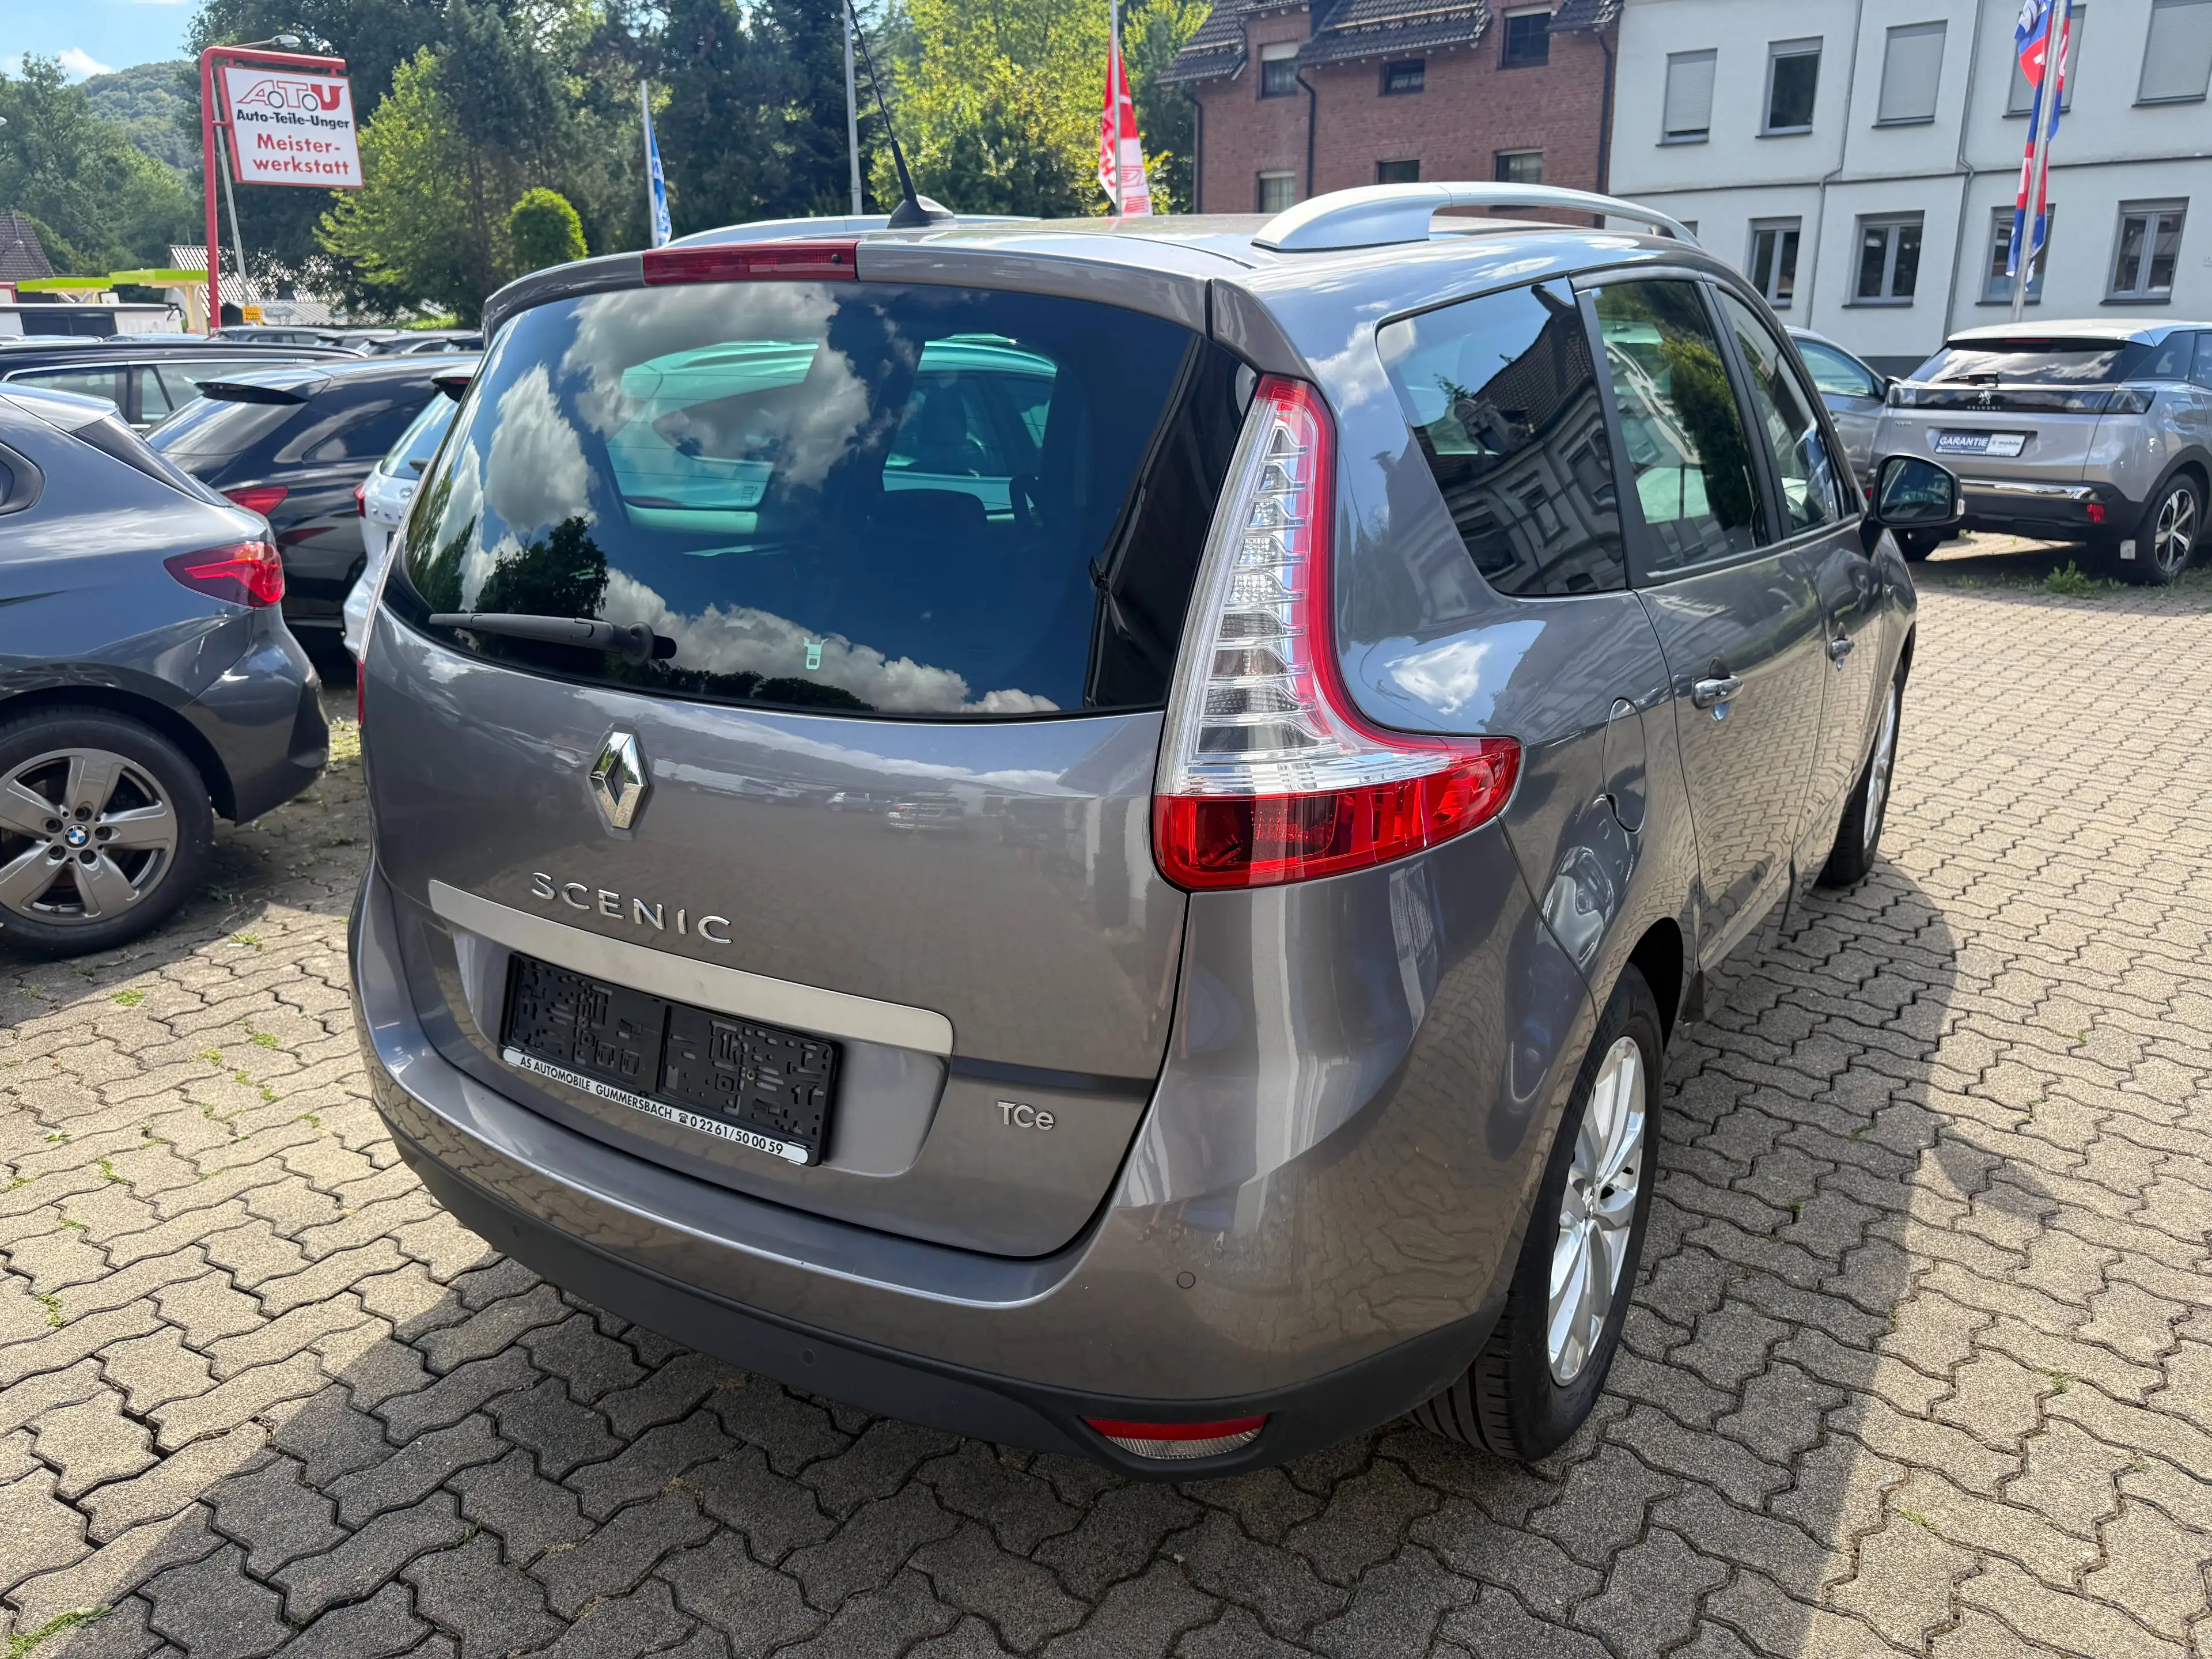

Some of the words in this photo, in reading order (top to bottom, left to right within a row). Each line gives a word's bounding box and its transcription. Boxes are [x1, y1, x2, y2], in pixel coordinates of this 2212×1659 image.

[236, 109, 350, 130] Auto-Teile-Unger
[257, 133, 341, 153] Meister-
[252, 156, 349, 175] werkstatt
[1939, 436, 1989, 447] GARANTIE
[532, 872, 733, 944] SCENIC
[520, 1056, 532, 1069] AS
[534, 1061, 591, 1091] AUTOMOBILE
[596, 1084, 672, 1119] GUMMERSBACH
[998, 1100, 1056, 1131] TCe
